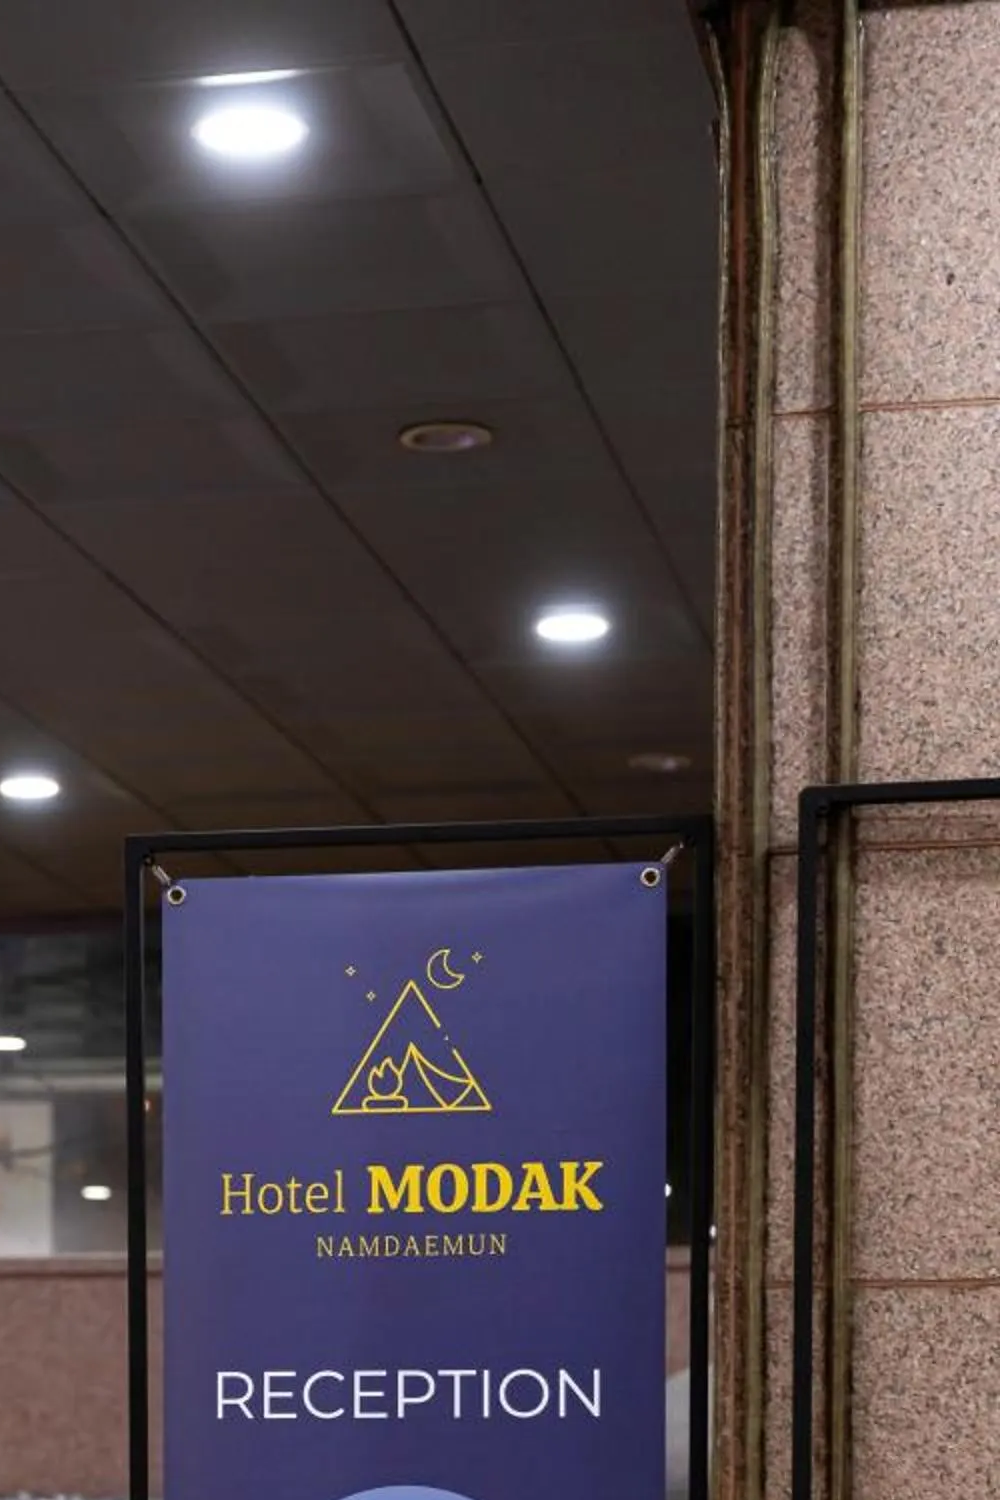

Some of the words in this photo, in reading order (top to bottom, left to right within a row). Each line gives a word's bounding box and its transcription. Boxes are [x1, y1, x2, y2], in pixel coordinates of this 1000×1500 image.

[219, 1168, 346, 1215] Hotel
[366, 1160, 604, 1214] MODAK
[316, 1233, 508, 1258] NAMDAEMUN
[216, 1368, 602, 1420] RECEPTION
